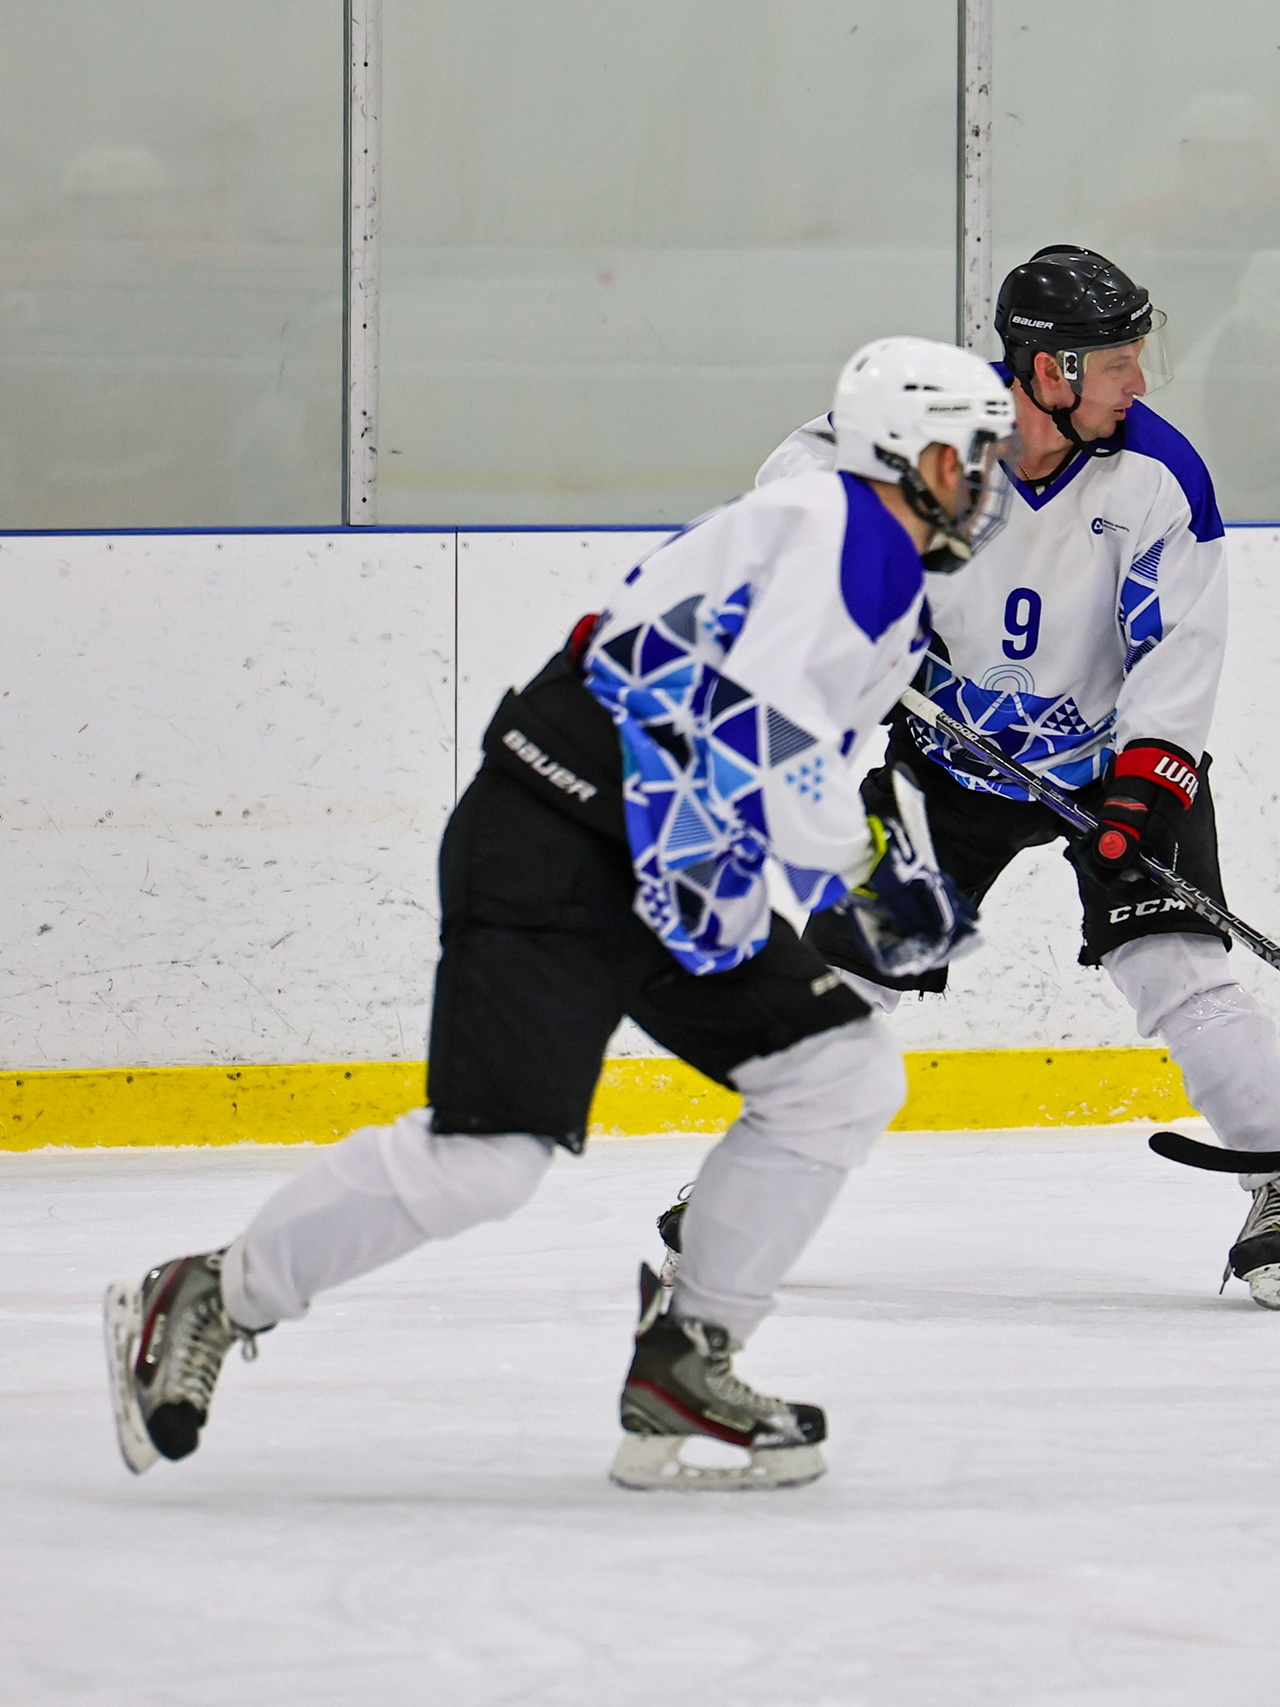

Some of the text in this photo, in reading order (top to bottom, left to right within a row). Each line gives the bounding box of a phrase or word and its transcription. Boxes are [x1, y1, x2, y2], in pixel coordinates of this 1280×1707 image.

[1011, 315, 1054, 330] BAUER
[1002, 587, 1042, 660] 9
[502, 729, 598, 803] BAUER
[1108, 898, 1187, 924] CCM
